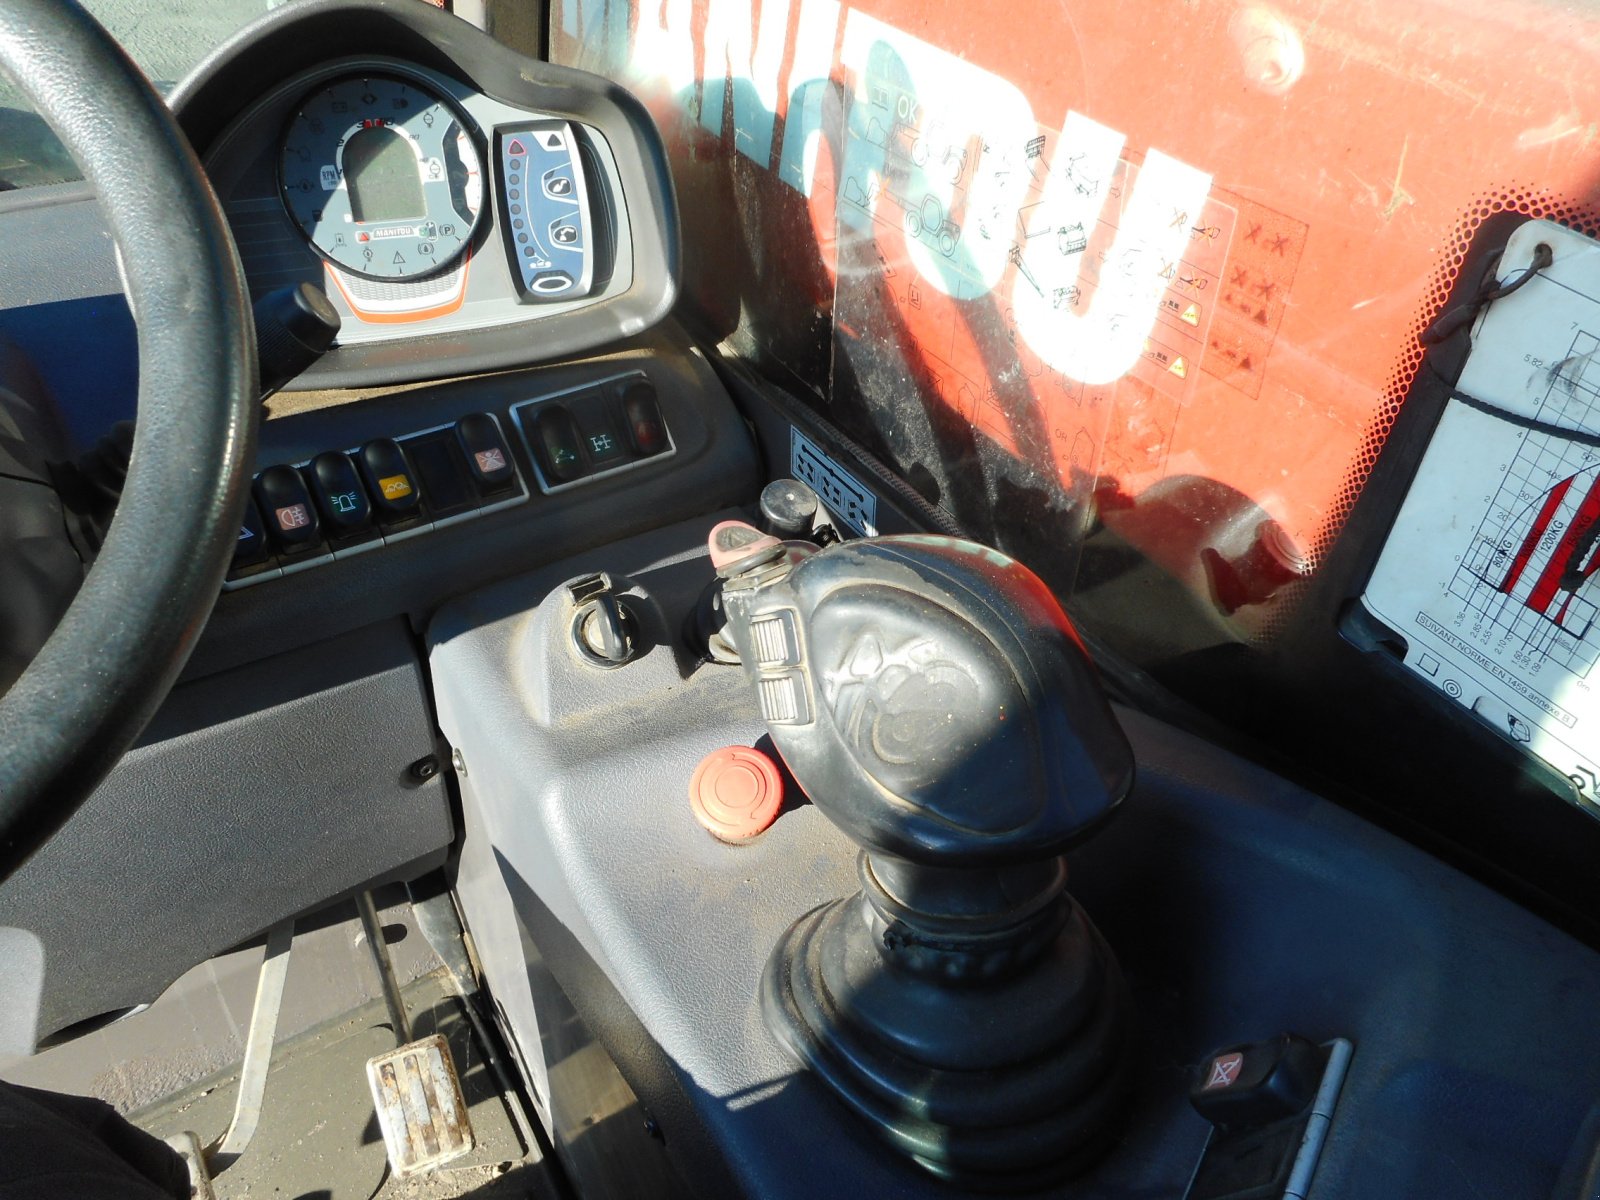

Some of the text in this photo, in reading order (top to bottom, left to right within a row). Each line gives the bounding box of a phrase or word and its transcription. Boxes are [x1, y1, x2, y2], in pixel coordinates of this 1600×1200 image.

[897, 95, 919, 122] OK
[375, 226, 412, 237] MANITOU
[1570, 321, 1579, 330] 7
[1523, 353, 1544, 369] 5.82
[1533, 397, 1540, 405] 5
[1516, 431, 1523, 439] 4
[1500, 463, 1507, 472] 3
[1484, 495, 1491, 503] 2
[1540, 519, 1564, 553] 1200KG
[1454, 554, 1461, 562] 0
[1492, 539, 1513, 568] 800KG
[1418, 615, 1457, 648] SUIVANT
[1456, 641, 1491, 668] NORME
[1491, 666, 1506, 679] EN
[1507, 676, 1528, 695] 1459
[1528, 691, 1560, 717] annexe
